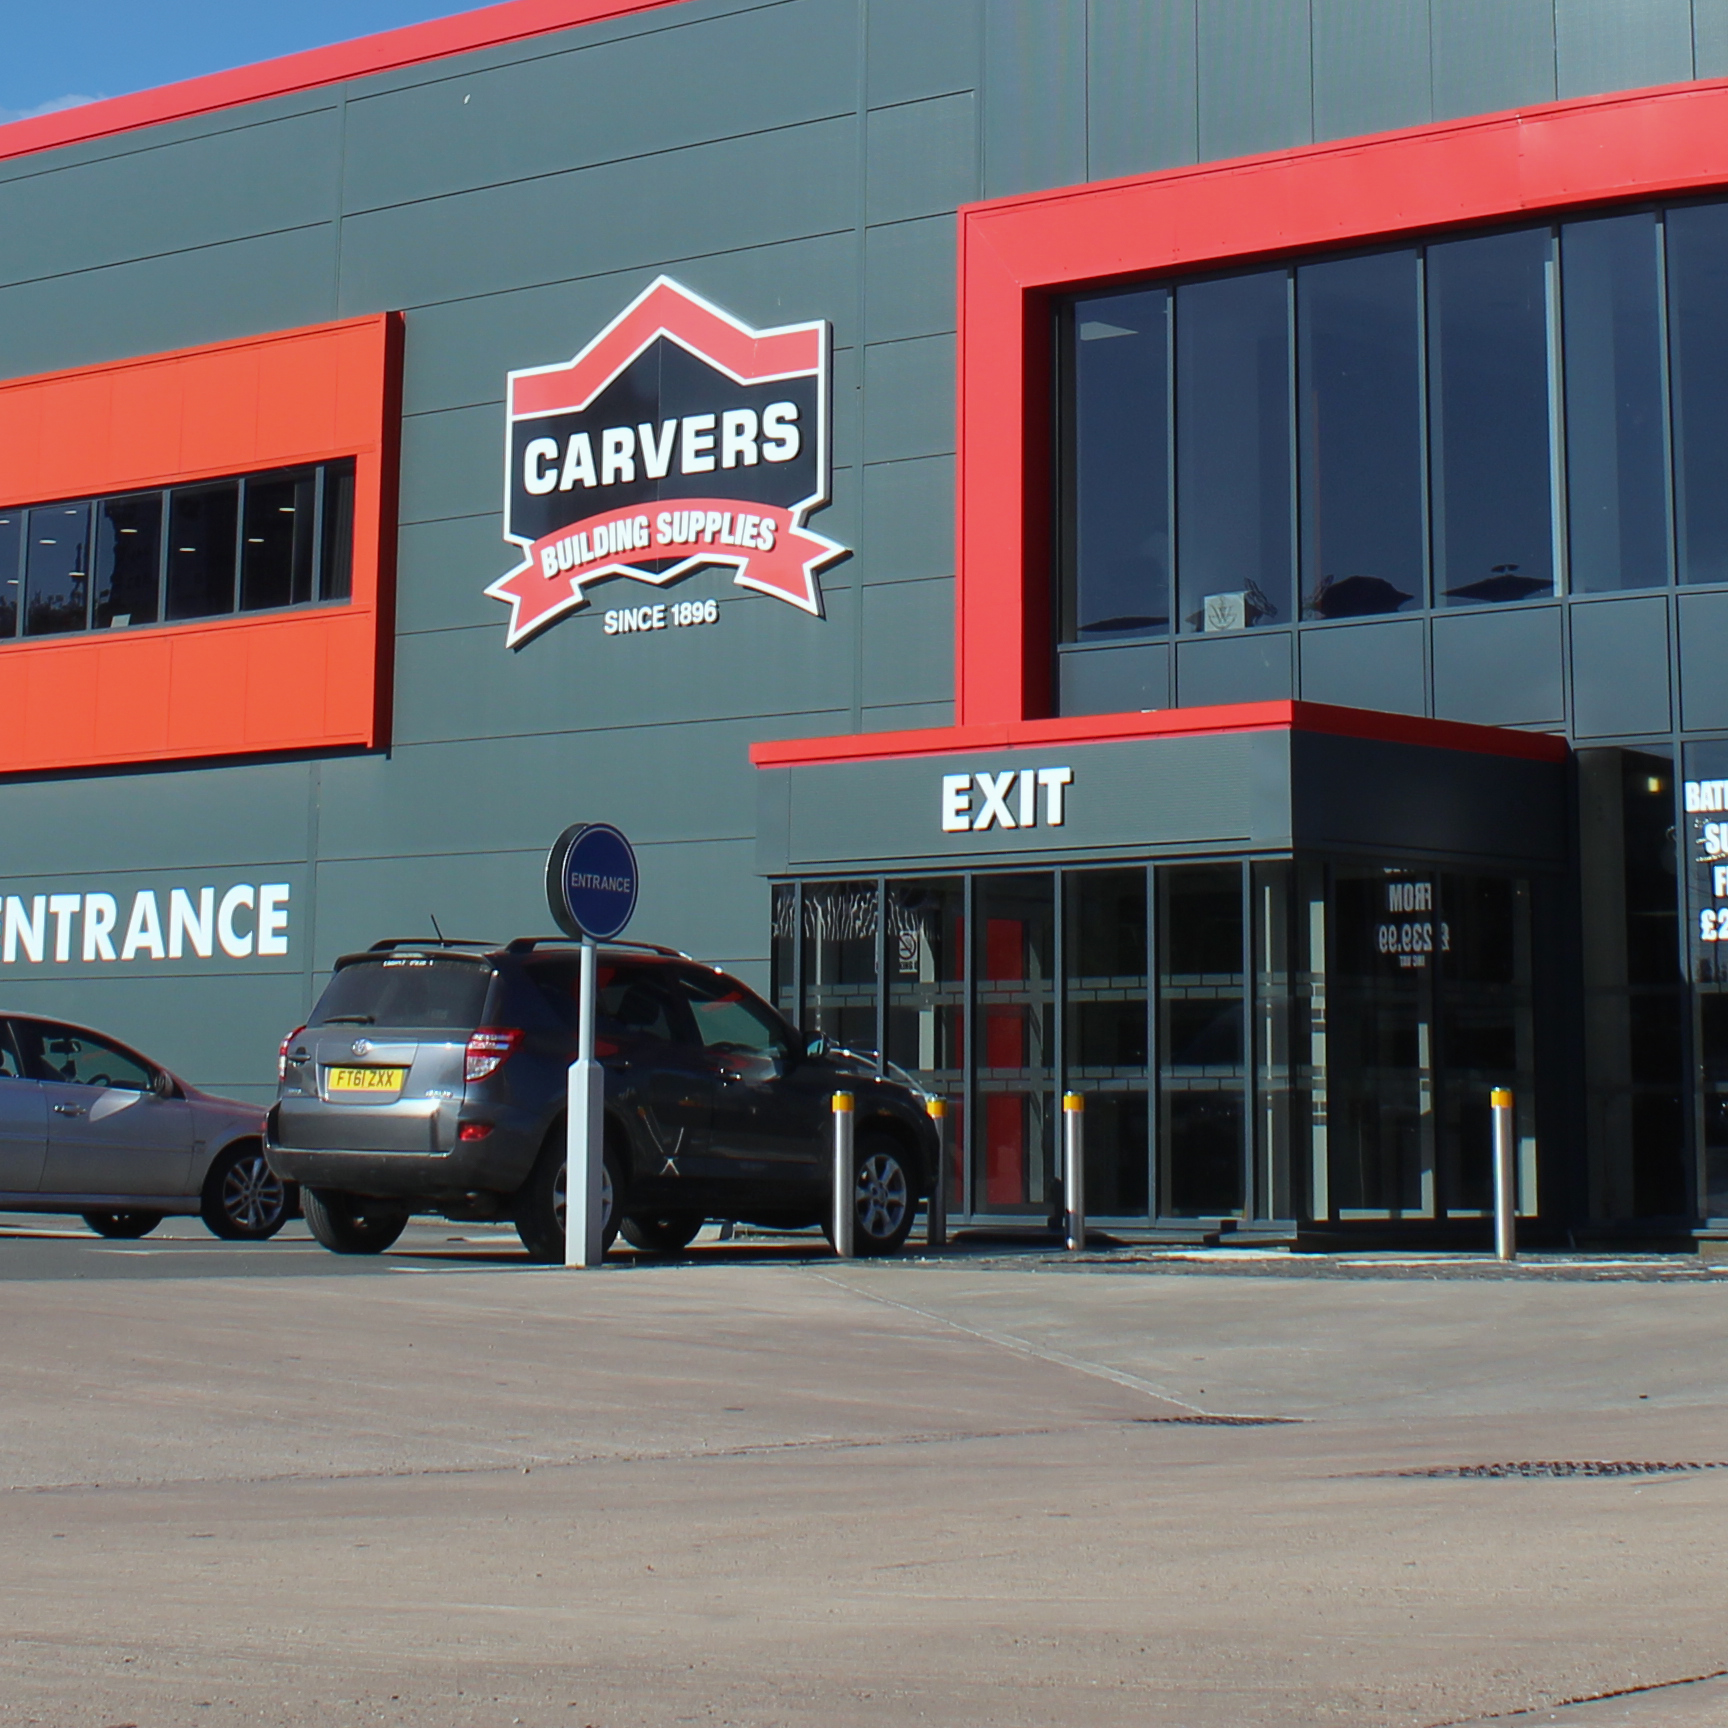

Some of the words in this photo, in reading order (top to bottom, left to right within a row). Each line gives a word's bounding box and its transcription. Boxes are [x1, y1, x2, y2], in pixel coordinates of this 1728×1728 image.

[523, 401, 801, 496] CARVERS
[540, 516, 649, 579] BUILDING
[655, 511, 777, 551] SUPPLIES
[604, 605, 666, 634] SINCE
[671, 599, 719, 627] 1896
[942, 766, 1074, 832] EXIT
[571, 872, 631, 892] ENTRANCE
[337, 1070, 366, 1087] FT61
[368, 1070, 394, 1087] ZXX
